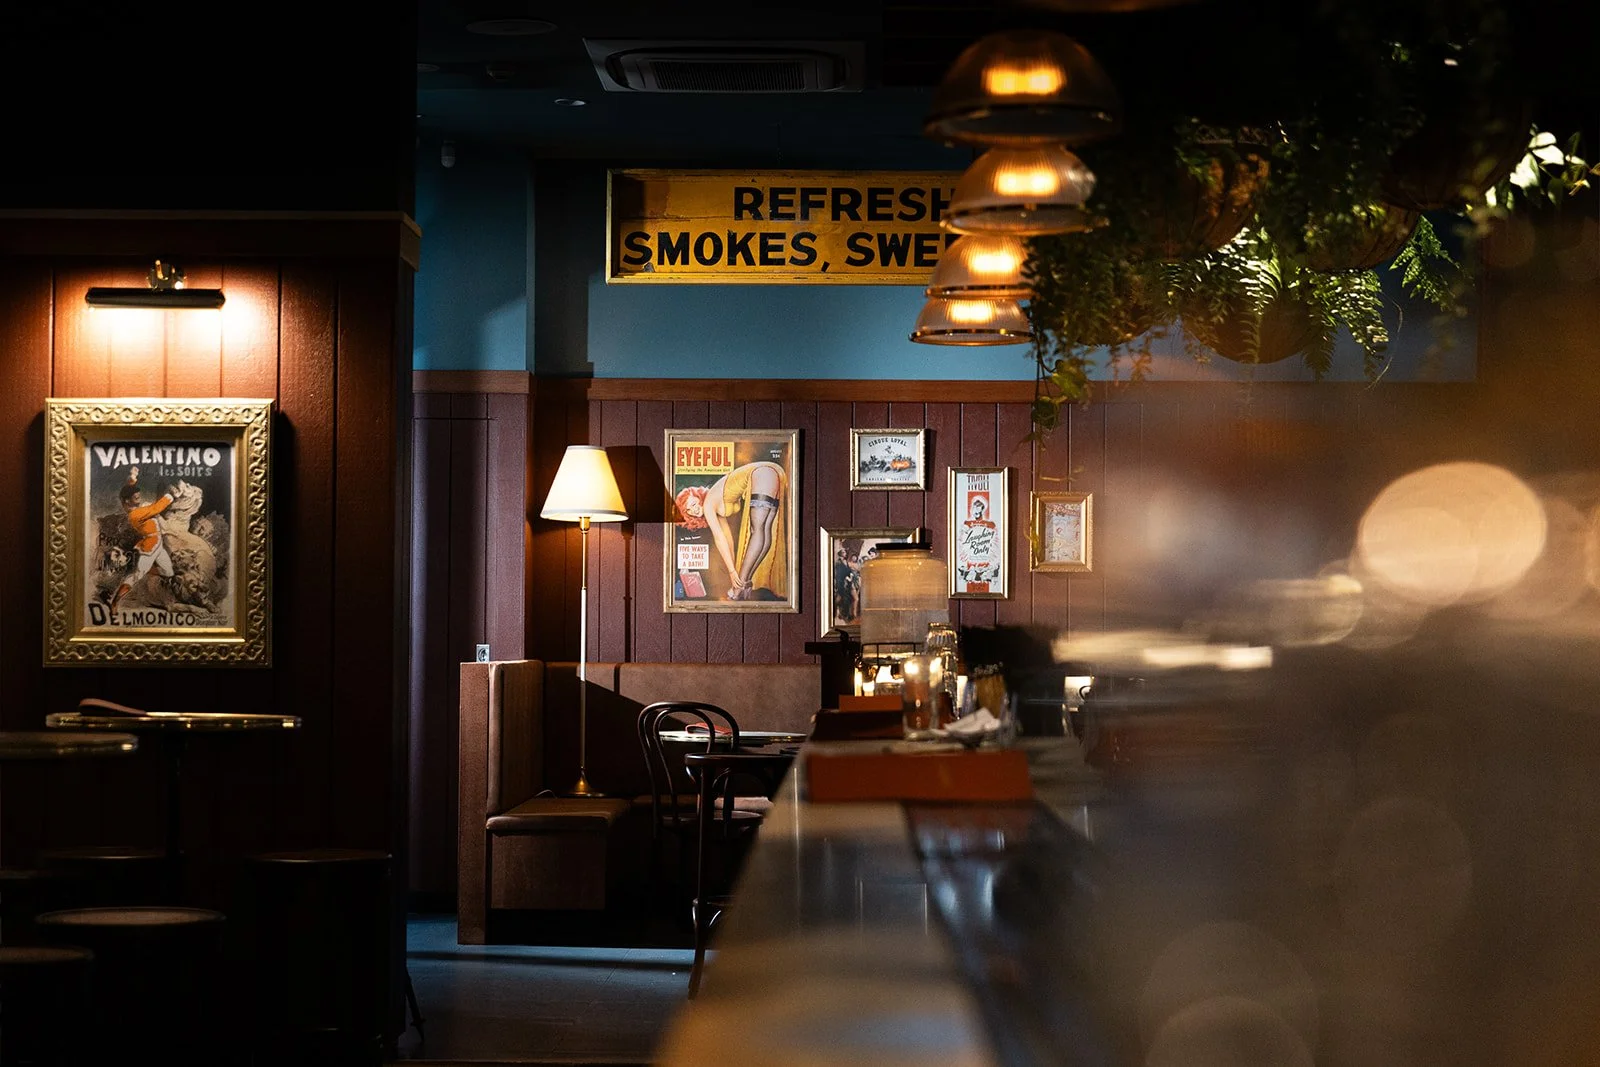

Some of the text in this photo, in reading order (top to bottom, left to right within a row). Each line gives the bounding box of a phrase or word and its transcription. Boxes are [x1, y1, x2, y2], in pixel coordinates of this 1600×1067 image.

[733, 187, 956, 222] REFRESH
[622, 230, 832, 272] SMOKES,
[94, 445, 221, 469] VALENTINO
[677, 446, 731, 467] EYEFUL
[88, 602, 196, 626] DELMONICO
